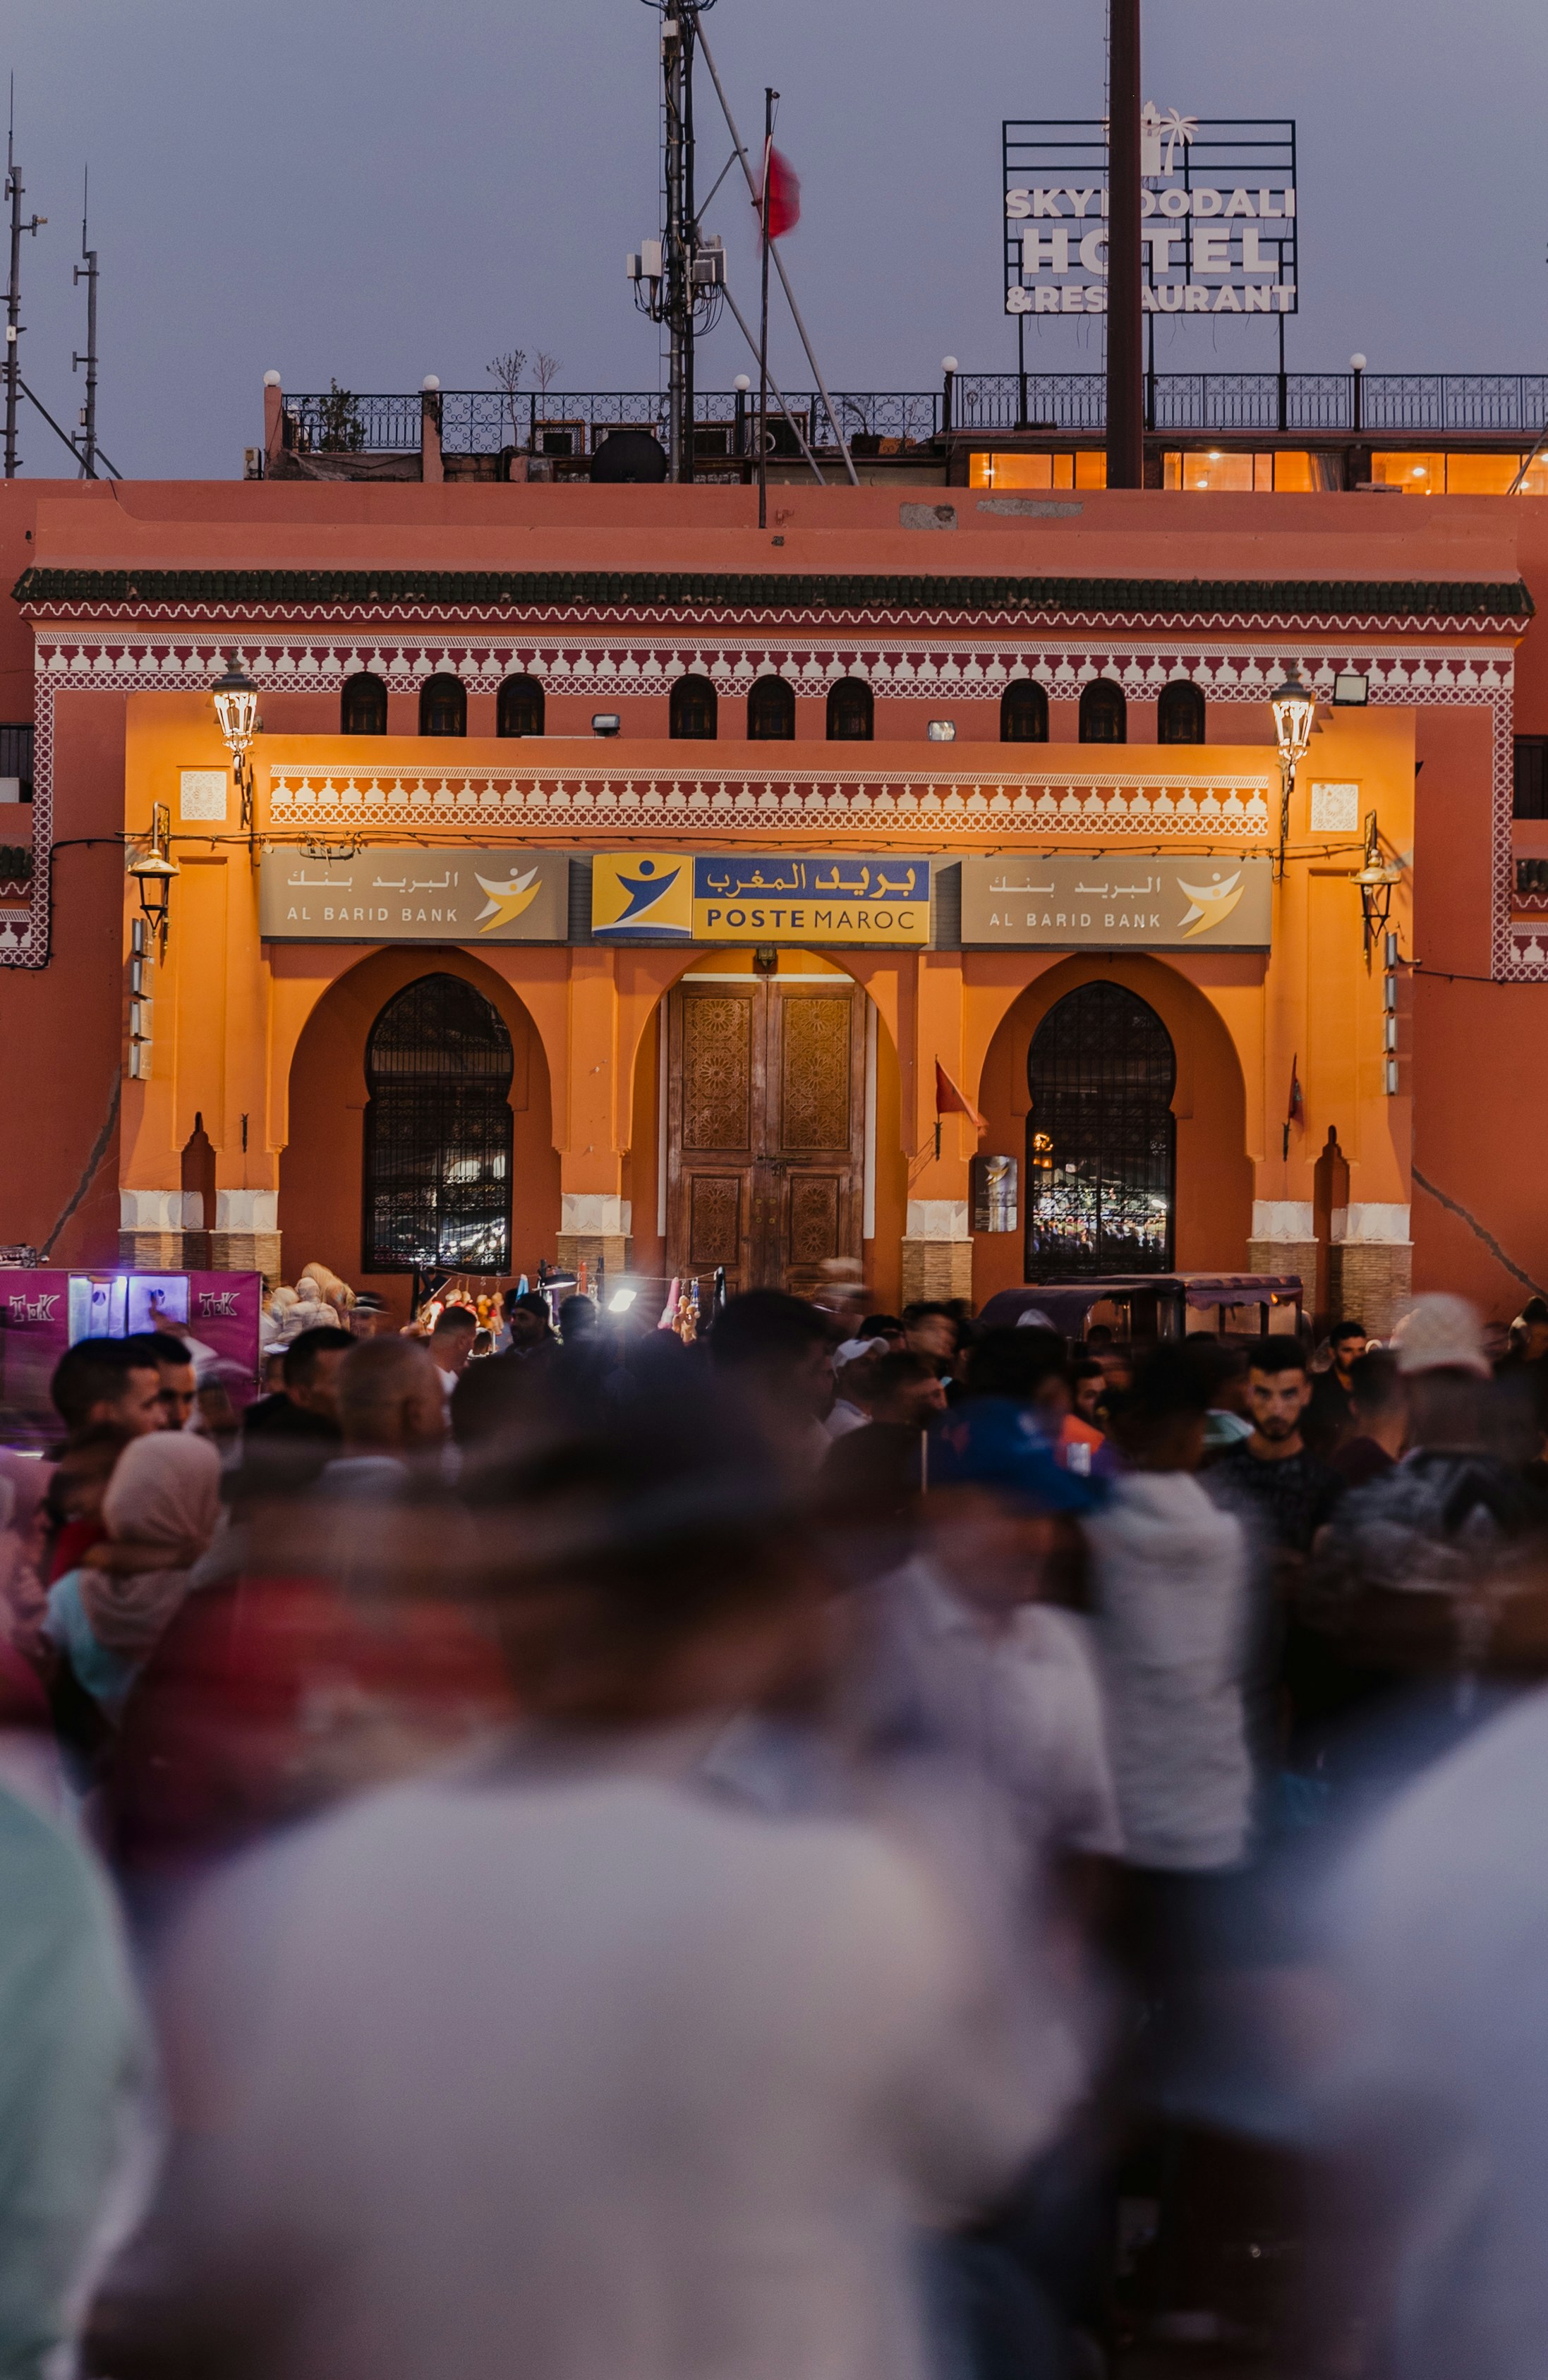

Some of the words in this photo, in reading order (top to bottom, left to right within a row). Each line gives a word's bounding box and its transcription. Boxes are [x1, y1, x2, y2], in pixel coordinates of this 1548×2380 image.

[1023, 228, 1279, 275] HOTEL
[1006, 285, 1296, 313] &RESAURANT
[288, 870, 352, 892] بنك
[373, 871, 458, 892] البريد
[707, 863, 806, 897] المغرب
[815, 866, 916, 898] بريد
[989, 876, 1055, 898] بنك
[1075, 877, 1161, 899] البريد
[287, 907, 311, 920] AL
[324, 907, 388, 921] BARID
[401, 908, 457, 921] BANK
[707, 909, 804, 928] POSTE
[814, 910, 914, 929] MAROC
[989, 913, 1013, 926] AL
[1027, 913, 1091, 927] BARID
[1104, 914, 1161, 928] BANK
